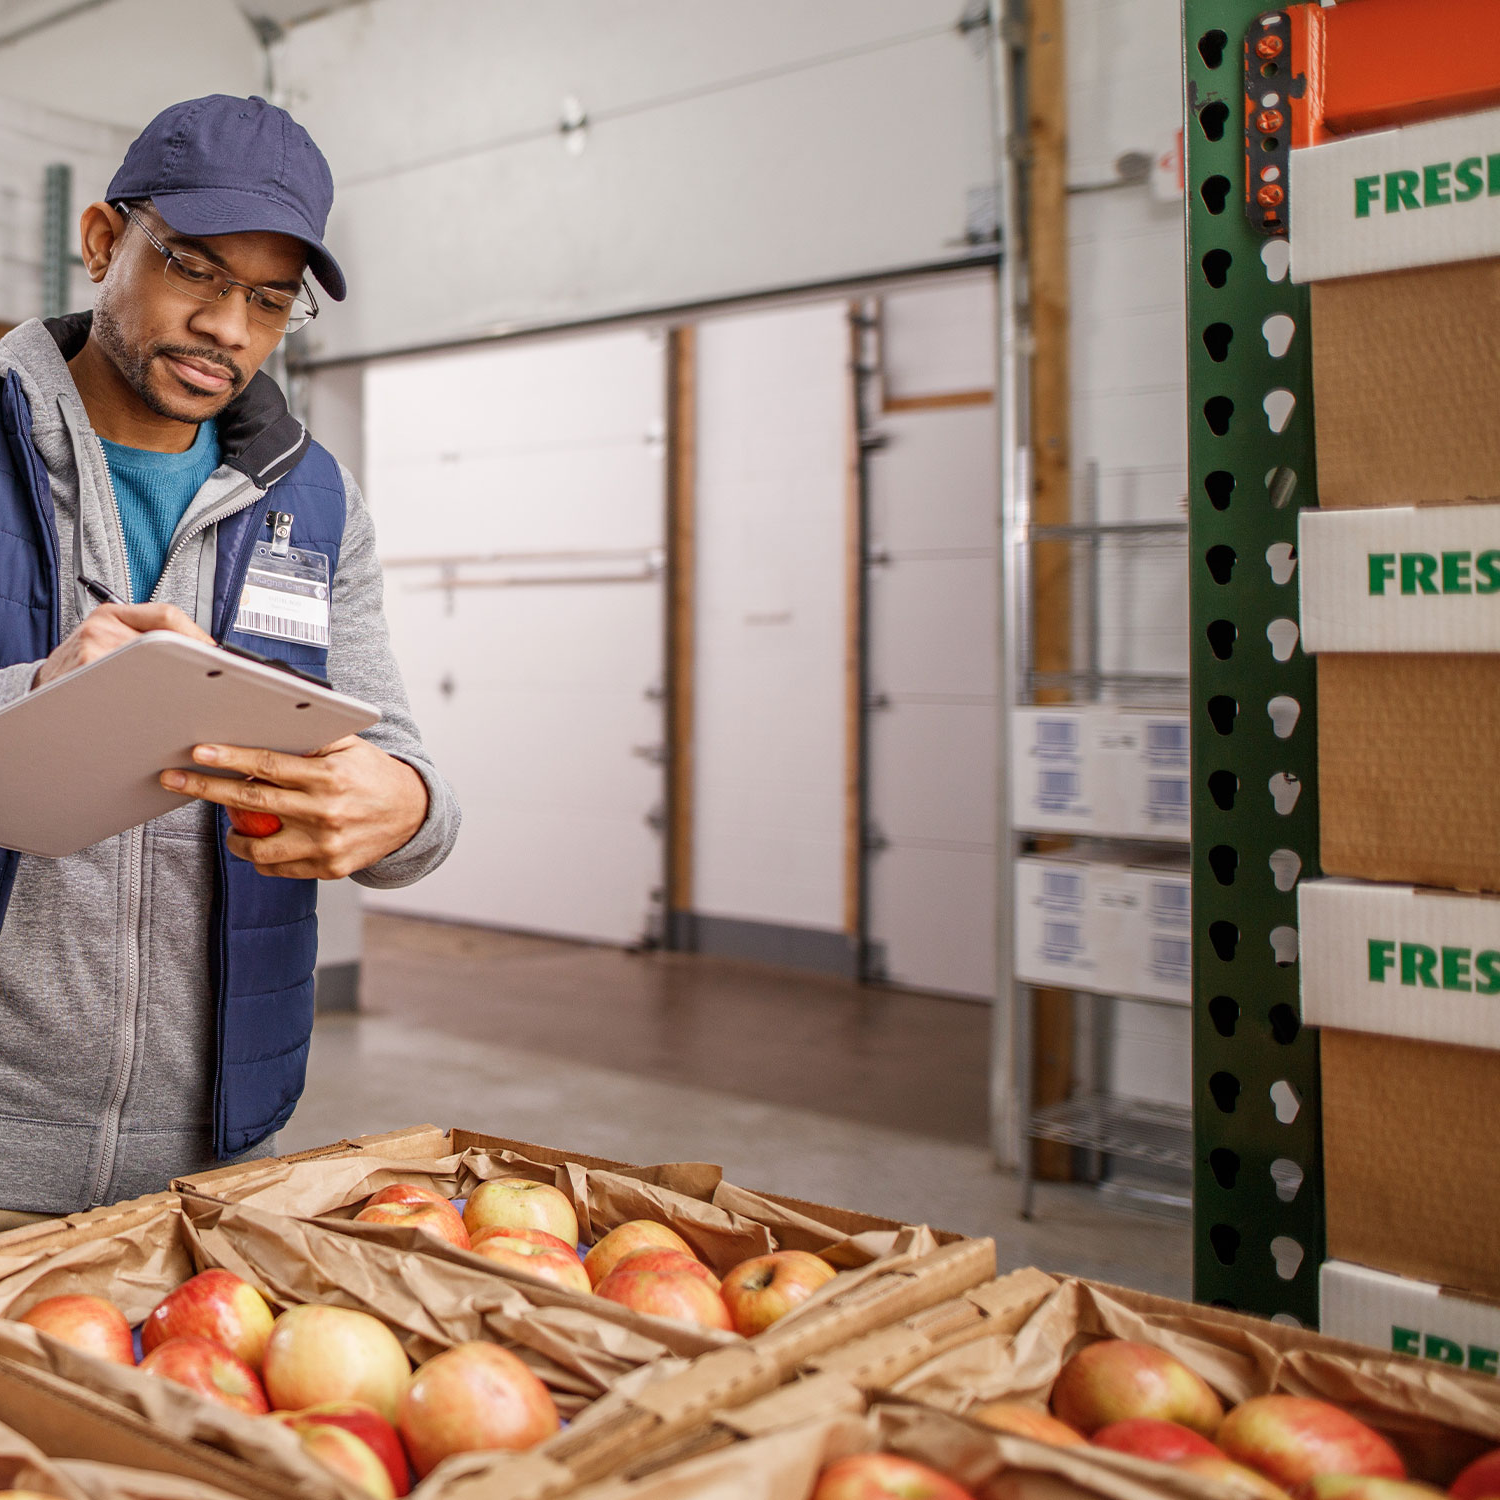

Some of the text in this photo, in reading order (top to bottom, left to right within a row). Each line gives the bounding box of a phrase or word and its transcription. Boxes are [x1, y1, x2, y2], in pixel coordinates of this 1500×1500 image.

[253, 574, 283, 588] Magna
[1367, 549, 1500, 596] FRES
[1367, 938, 1500, 995] FRES
